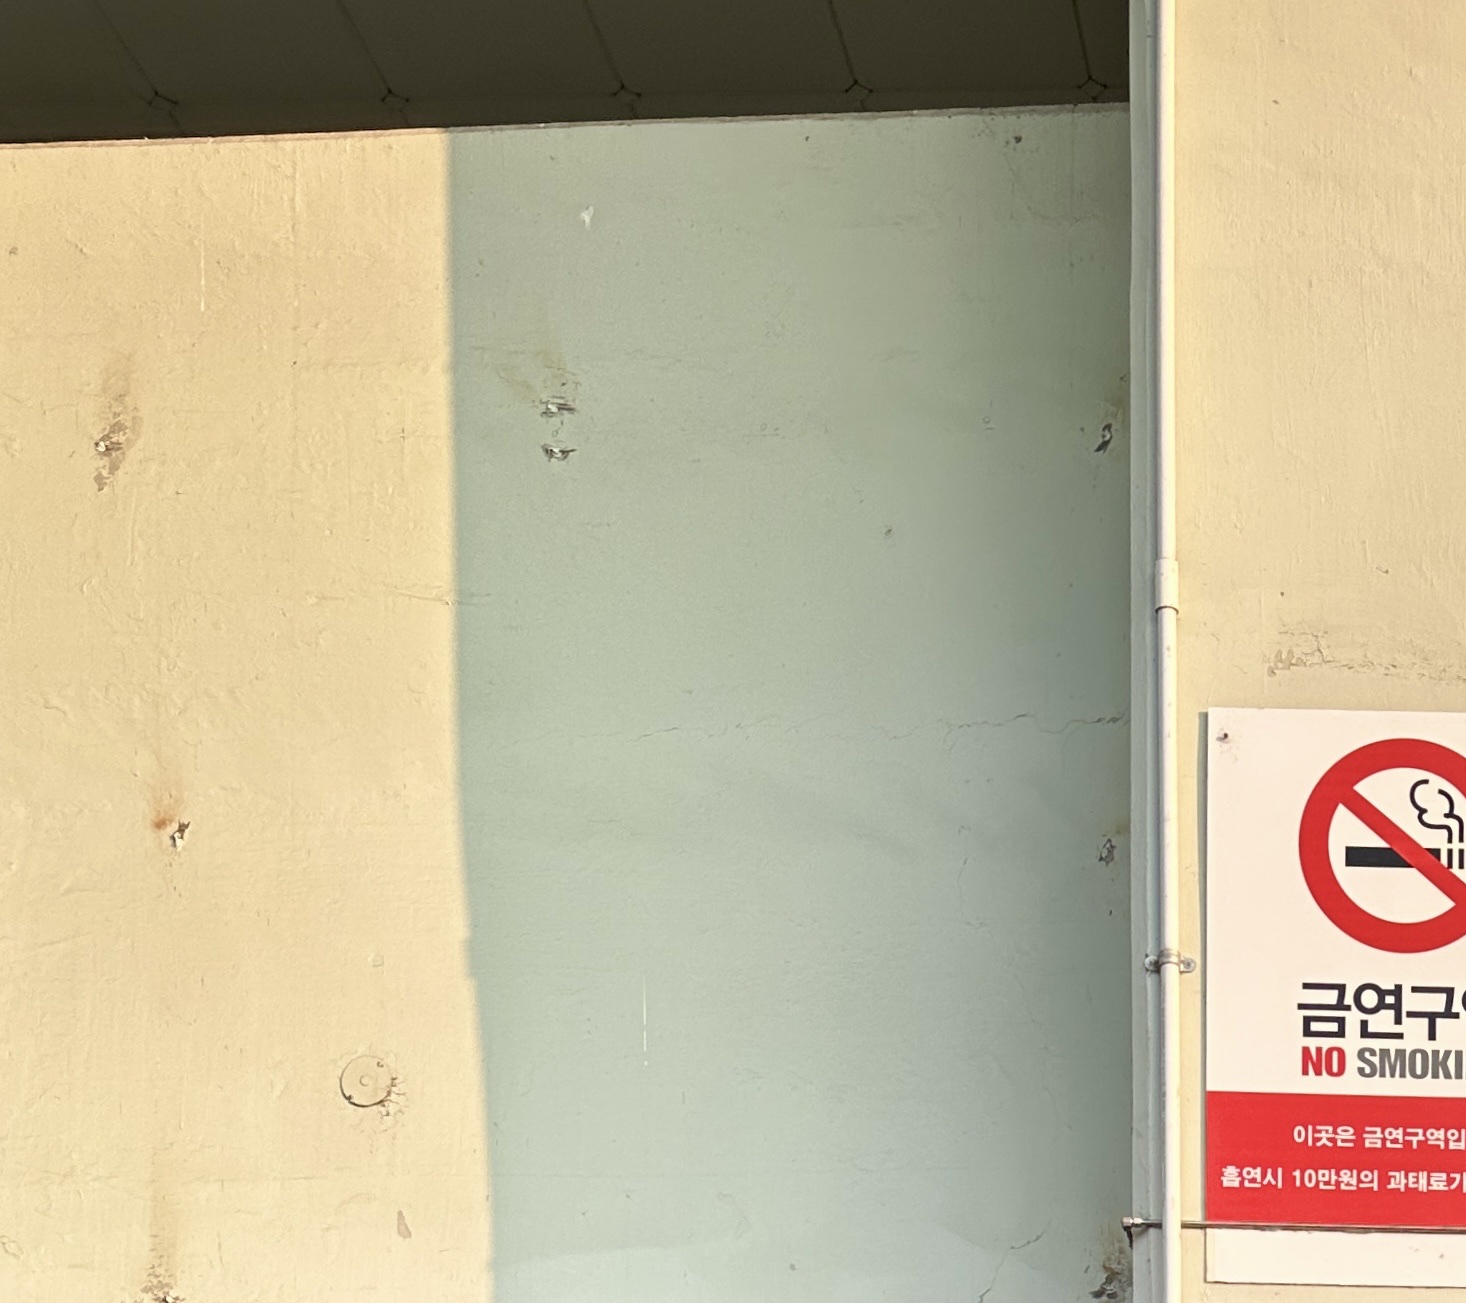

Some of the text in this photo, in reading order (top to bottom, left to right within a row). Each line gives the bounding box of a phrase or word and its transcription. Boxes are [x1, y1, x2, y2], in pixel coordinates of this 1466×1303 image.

[1301, 1046, 1346, 1077] NO
[1293, 1126, 1355, 1149] 이곳은
[1220, 1166, 1284, 1190] 흡연시
[1291, 1168, 1379, 1191] 10만원의
